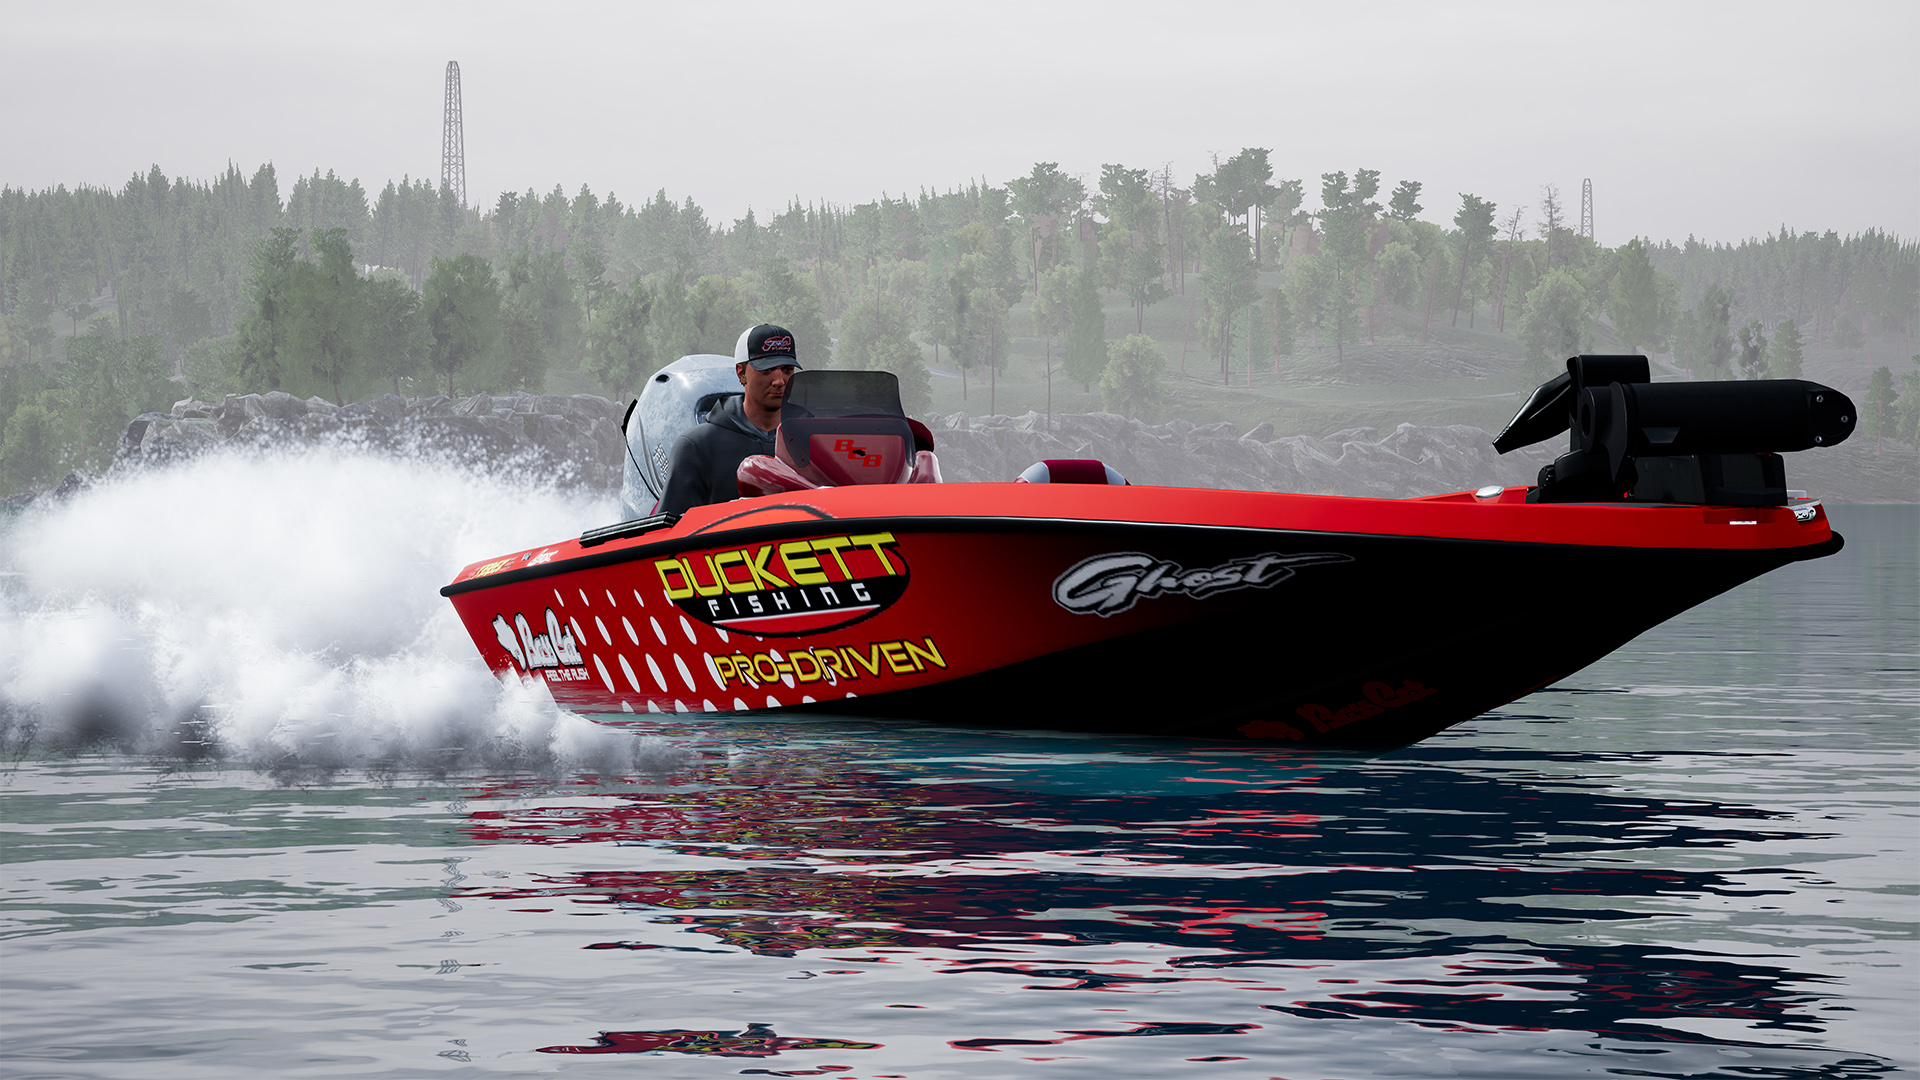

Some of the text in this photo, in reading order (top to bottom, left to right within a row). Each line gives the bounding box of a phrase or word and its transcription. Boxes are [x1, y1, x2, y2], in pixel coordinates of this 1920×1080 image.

[654, 532, 897, 600] DUCKETT
[1053, 551, 1355, 617] Ghost
[707, 582, 872, 617] FISHING
[545, 669, 559, 682] FEEL
[571, 668, 591, 681] RUSH
[713, 636, 948, 687] PRO-DRIVEN
